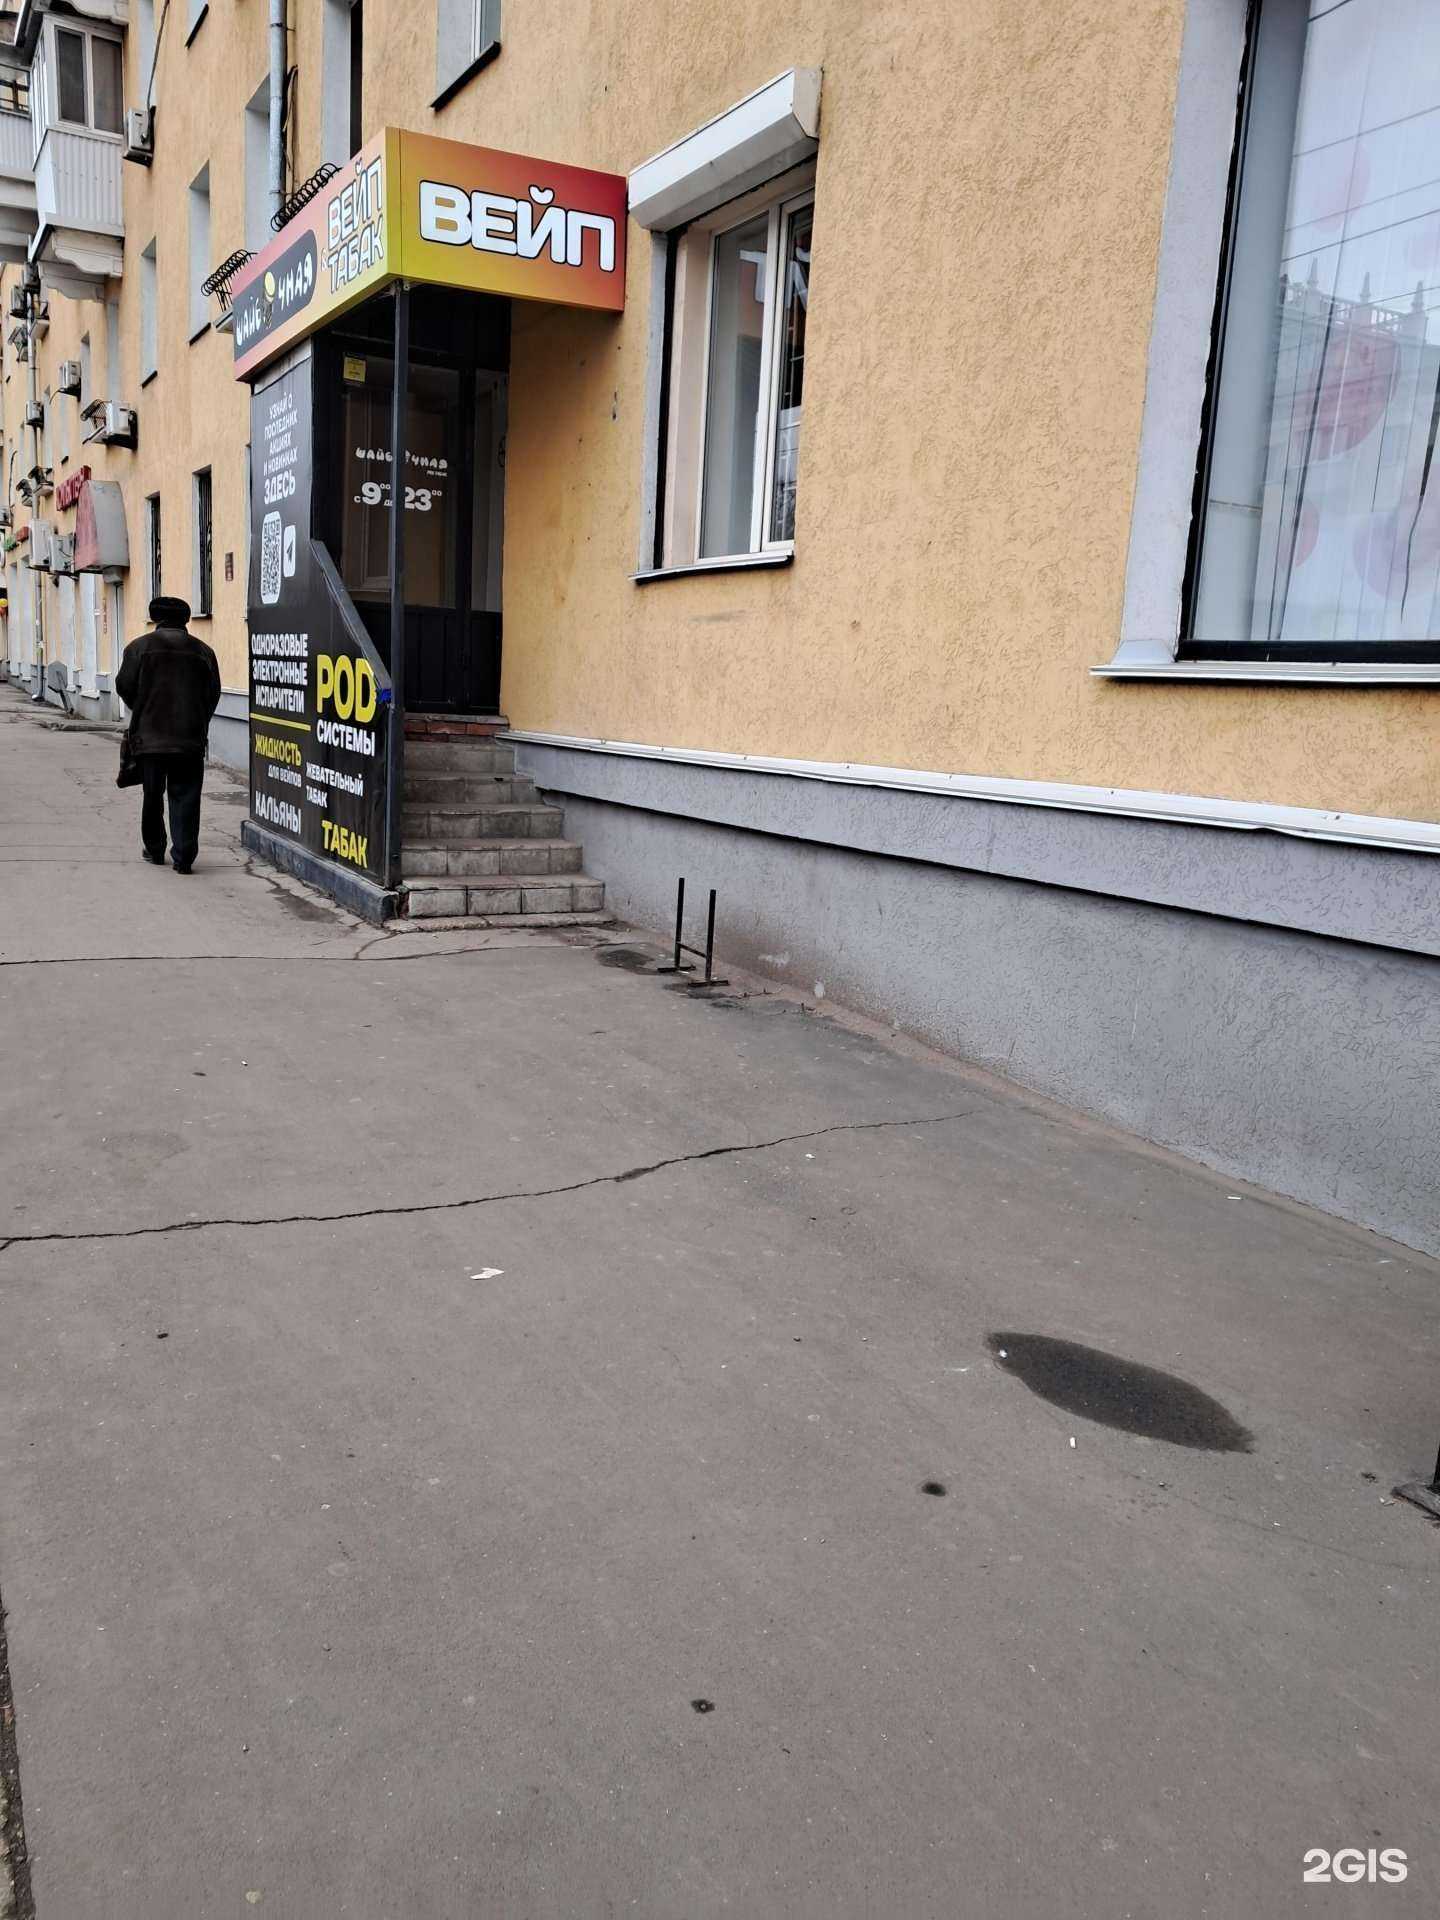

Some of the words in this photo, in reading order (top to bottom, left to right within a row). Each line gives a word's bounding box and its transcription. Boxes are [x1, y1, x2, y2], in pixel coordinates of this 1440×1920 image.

[328, 156, 383, 250] ВЕЙП
[420, 180, 615, 272] ВЕЙП
[327, 215, 384, 295] ТАБАК
[269, 392, 287, 420] УЗНАЙ
[264, 410, 298, 440] ПОСЛЕДНИХ
[269, 432, 292, 456] АКЦИЯХ
[263, 459, 268, 477] И
[268, 447, 298, 472] НОВИНКАХ
[264, 469, 296, 505] ЗДЕСЬ
[251, 633, 309, 657] ОДНОРАЗОВЫЕ
[252, 661, 308, 685] ЭЛЕКТРОННЫЕ
[316, 654, 377, 724] POD
[255, 687, 305, 714] ИСПАРИТЕЛИ
[255, 734, 302, 767] ЖИДКОСТЬ
[316, 719, 376, 757] СИСТЕМЫ
[279, 766, 302, 788] ВЕЙПОВ
[306, 761, 364, 797] ЖЕВАТЕЛЬНЫЙ
[255, 791, 302, 835] КАЛЬЯНЫ
[306, 784, 328, 809] ТАБАК
[321, 820, 369, 869] ТАБАК
